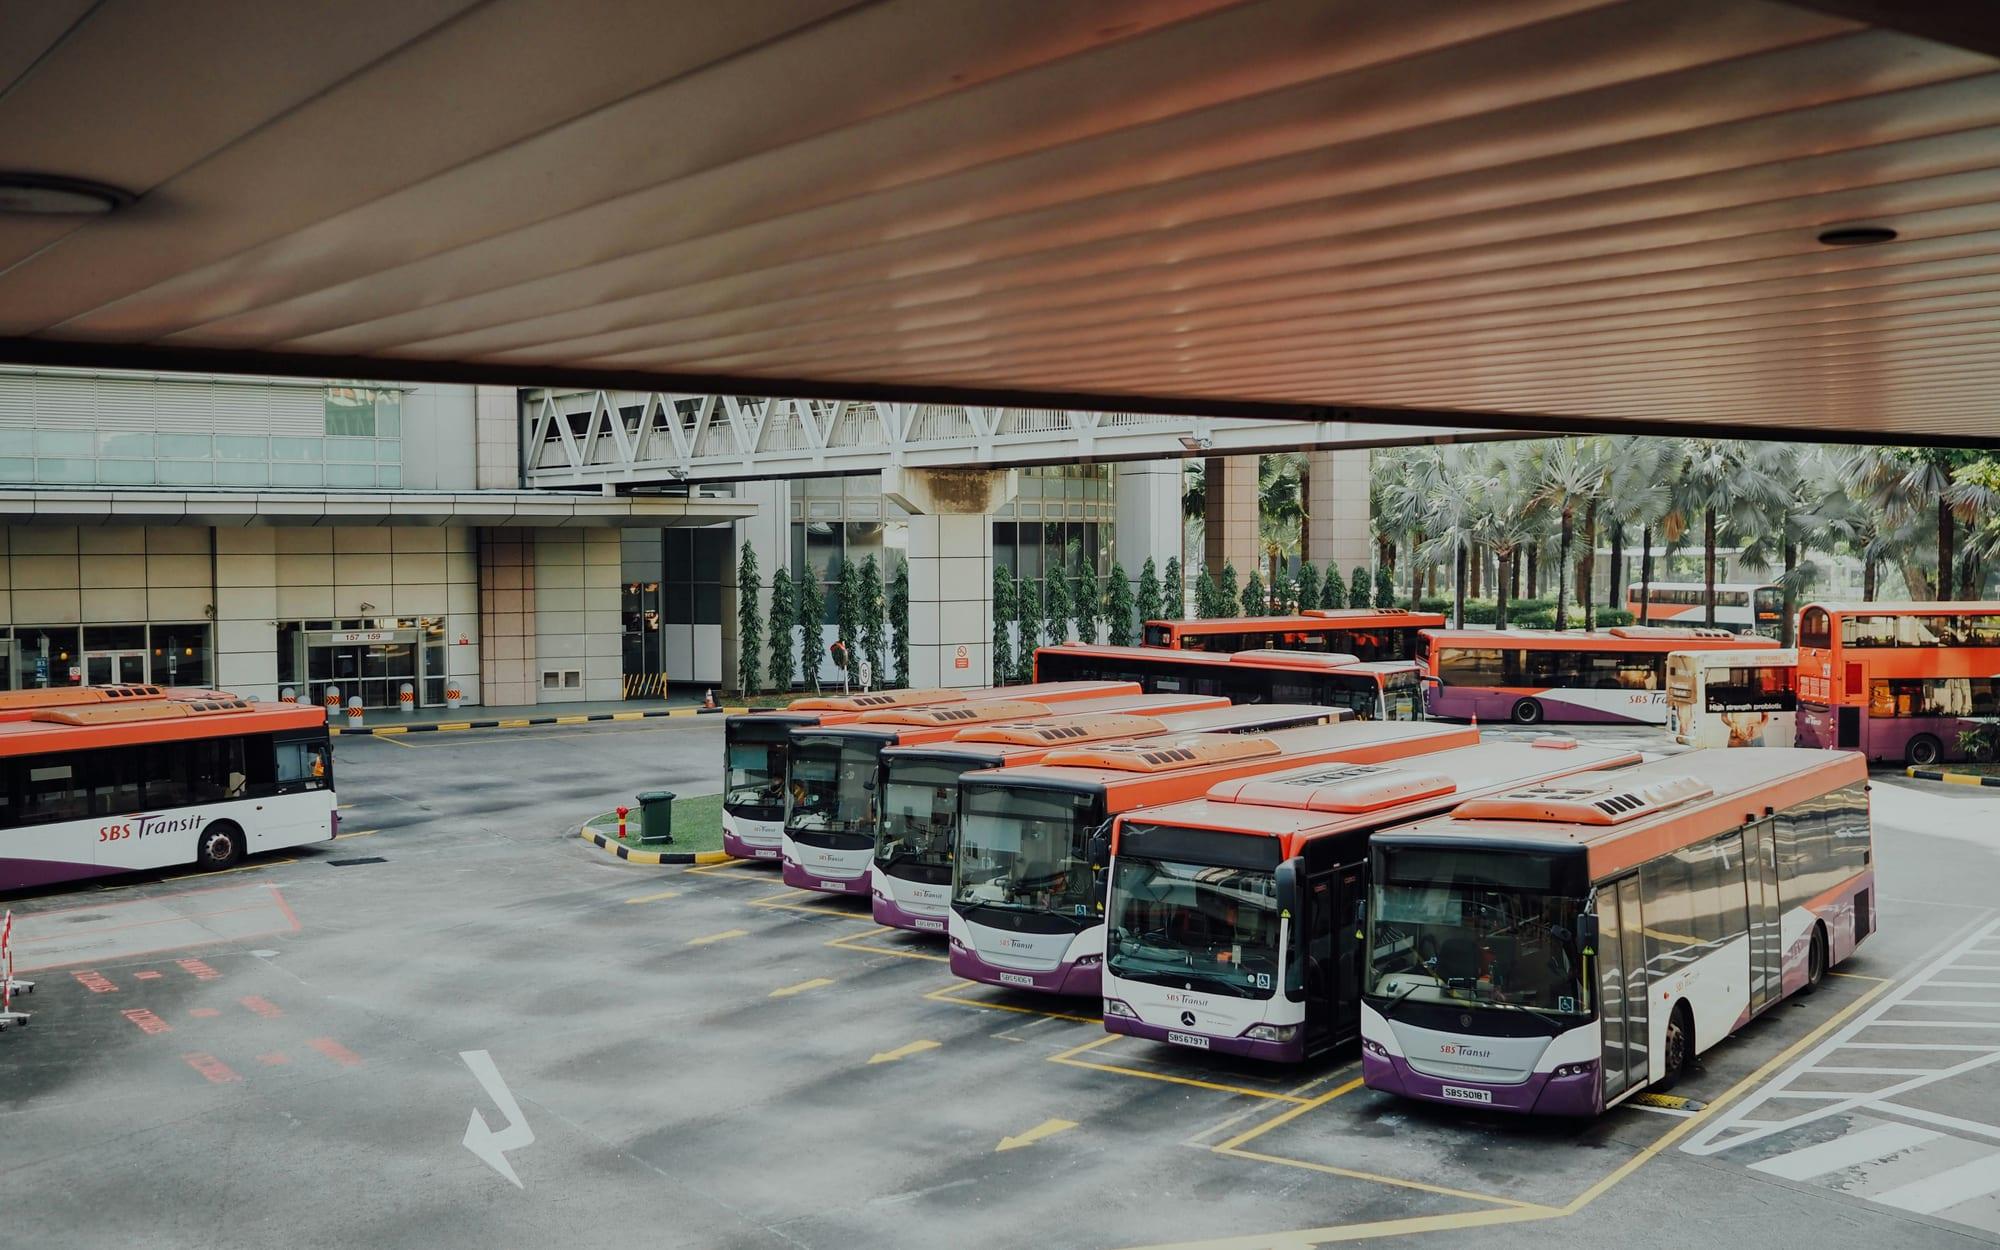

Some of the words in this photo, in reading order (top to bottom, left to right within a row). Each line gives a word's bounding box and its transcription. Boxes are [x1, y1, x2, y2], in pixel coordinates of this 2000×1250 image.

[345, 633, 360, 641] 157
[367, 633, 381, 641] 159
[862, 668, 868, 678] 15
[1629, 694, 1648, 704] SBS
[1709, 703, 1725, 711] High
[1726, 703, 1752, 711] strength
[98, 823, 131, 842] SBS
[129, 815, 207, 840] Transit
[1010, 939, 1033, 950] Transit
[1166, 993, 1179, 1001] SBS
[1181, 994, 1209, 1007] Transit
[1440, 1044, 1456, 1054] SBS
[1456, 1044, 1490, 1058] Transit
[1445, 1088, 1489, 1101] SBS5018T
